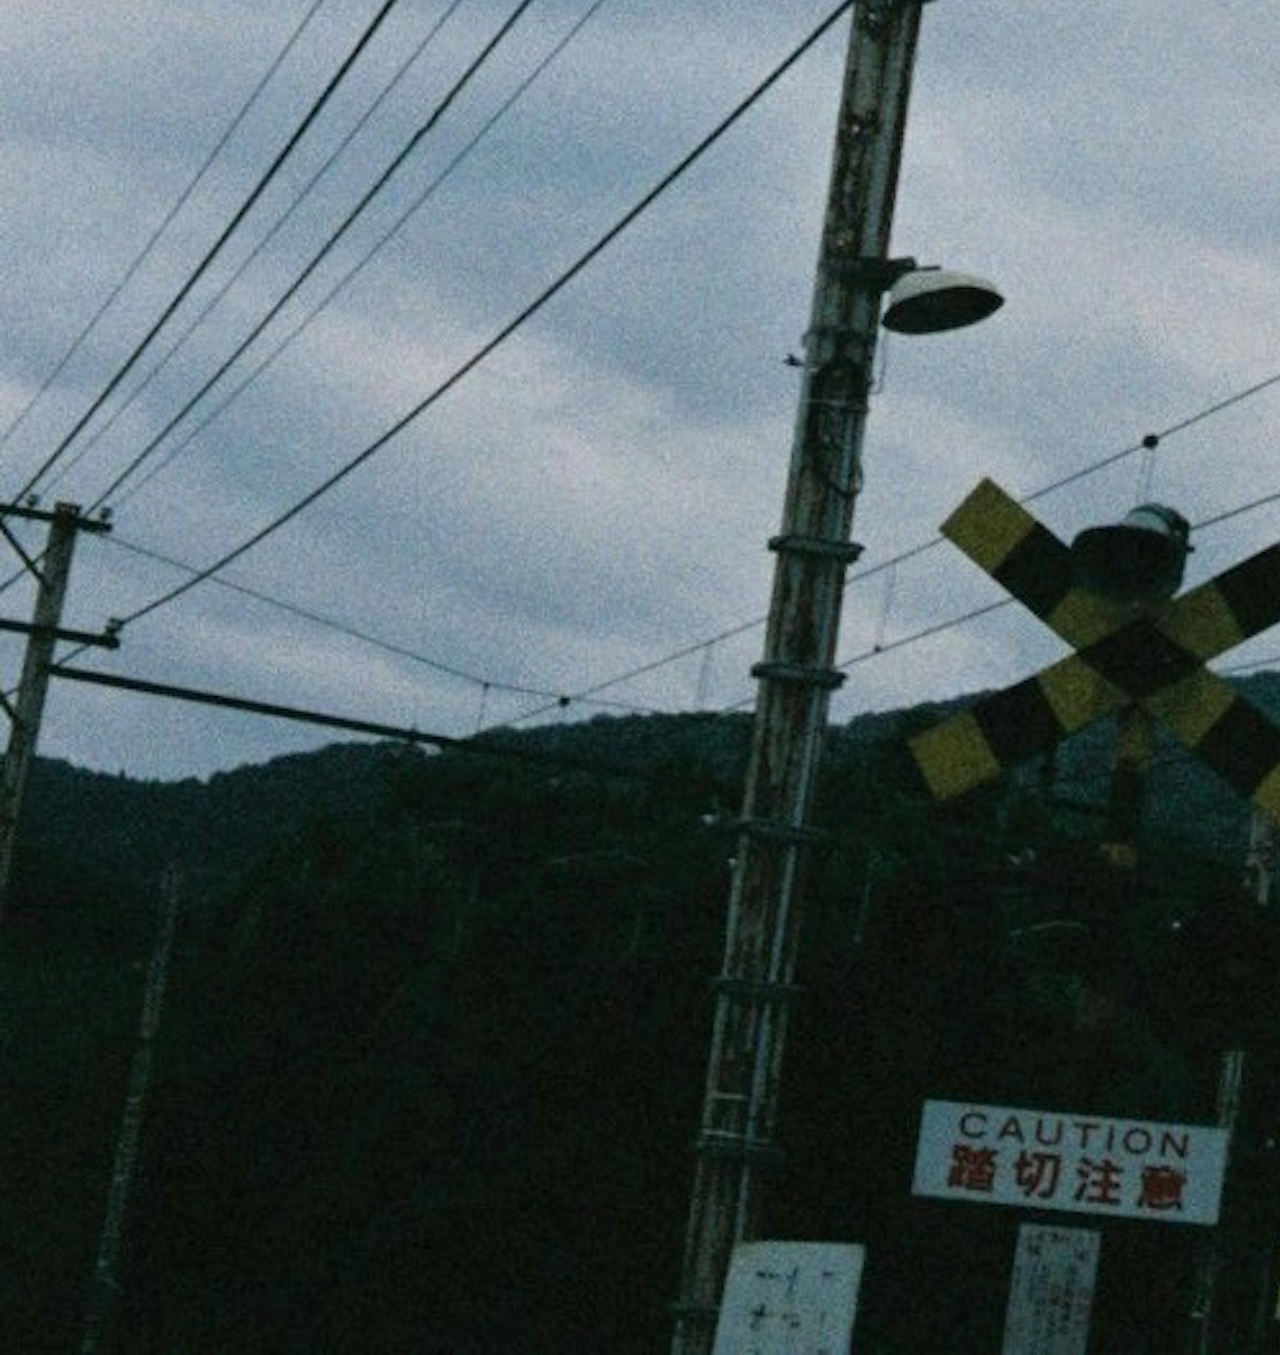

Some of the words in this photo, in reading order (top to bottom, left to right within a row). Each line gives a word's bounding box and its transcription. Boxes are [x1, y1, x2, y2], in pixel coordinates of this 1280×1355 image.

[960, 1112, 1188, 1157] CAUTION
[948, 1144, 1186, 1210] 踏切注意
